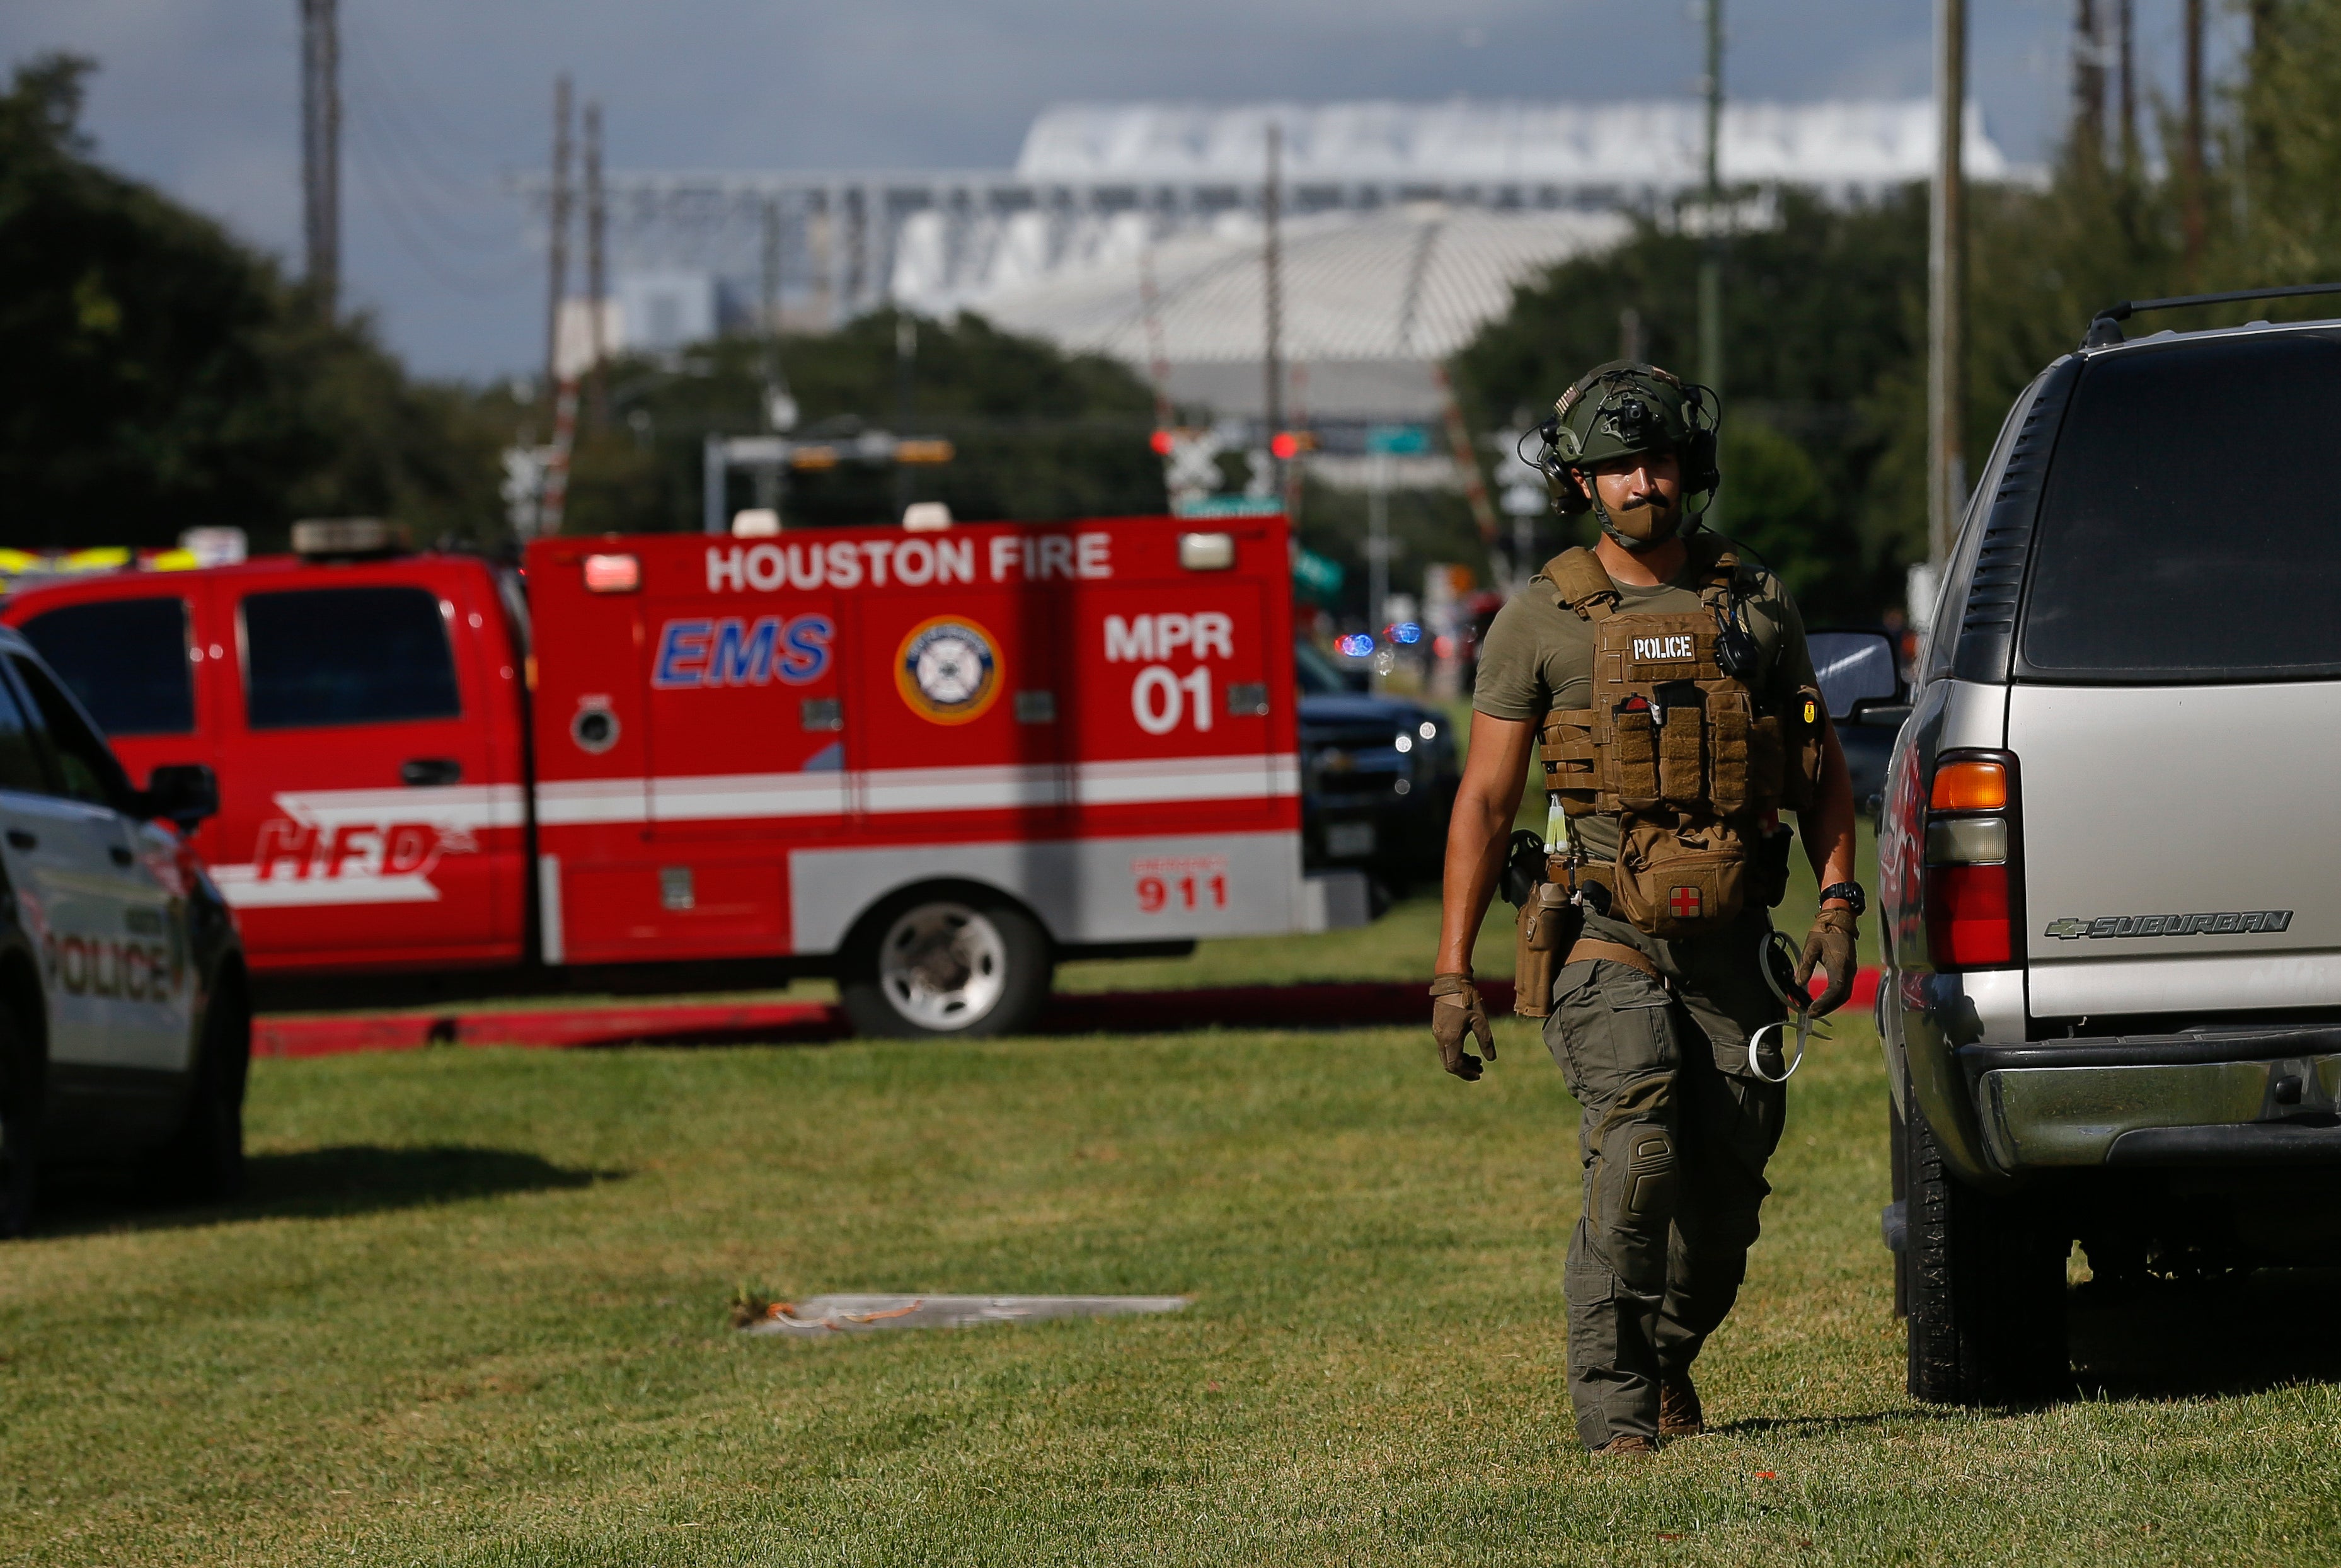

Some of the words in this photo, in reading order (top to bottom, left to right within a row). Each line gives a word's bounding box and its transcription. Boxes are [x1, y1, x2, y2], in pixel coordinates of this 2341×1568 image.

[706, 538, 974, 592] HOUSTON
[989, 532, 1113, 582] FIRE
[650, 613, 836, 690] EMS
[1104, 612, 1234, 663] MPR
[1633, 636, 1692, 660] POLICE
[1131, 665, 1213, 735] 01
[253, 819, 442, 883] HFD
[1136, 873, 1229, 913] 911
[2089, 911, 2294, 939] SUBURBAN
